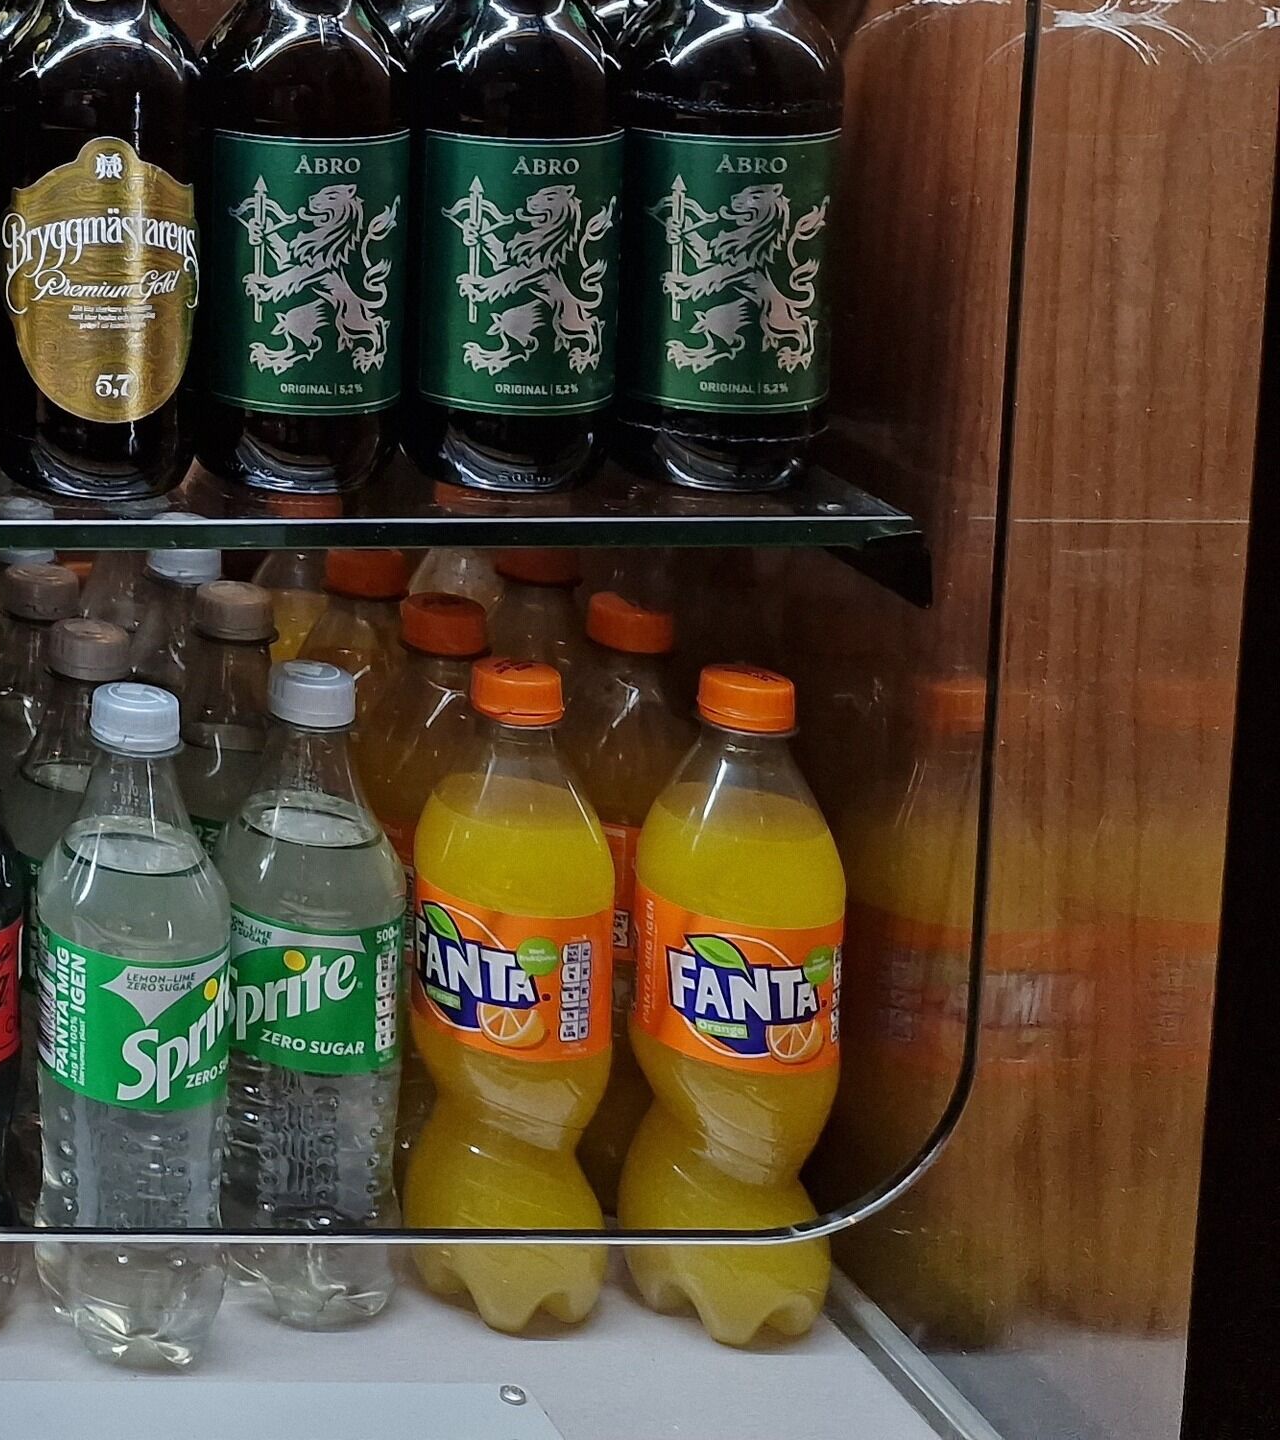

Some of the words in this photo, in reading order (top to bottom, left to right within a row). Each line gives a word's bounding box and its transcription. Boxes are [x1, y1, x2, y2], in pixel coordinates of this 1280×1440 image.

[294, 154, 361, 175] ÅBRO
[512, 155, 580, 175] ÅBRO
[715, 154, 788, 174] ÅBRO
[2, 199, 199, 304] Bryggmästarens
[36, 269, 138, 300] Premium
[140, 269, 181, 303] Gold
[280, 383, 332, 395] ORIGINAL
[340, 383, 363, 395] 5,2%
[495, 383, 548, 395] ORIGINAL
[556, 384, 579, 395] 5,2%
[699, 382, 755, 394] ORIGINAL
[763, 382, 788, 394] 5,2%
[55, 946, 70, 996] MIG
[416, 916, 536, 1004] FANTA
[70, 953, 87, 1014] IGEN
[126, 981, 157, 991] ZERO
[158, 981, 193, 991] SUGAR
[668, 949, 818, 1022] FANTA
[55, 1000, 70, 1079] PANTA
[260, 1029, 306, 1051] ZERO
[309, 1040, 365, 1055] SUGAR
[184, 1066, 218, 1090] ZERO
